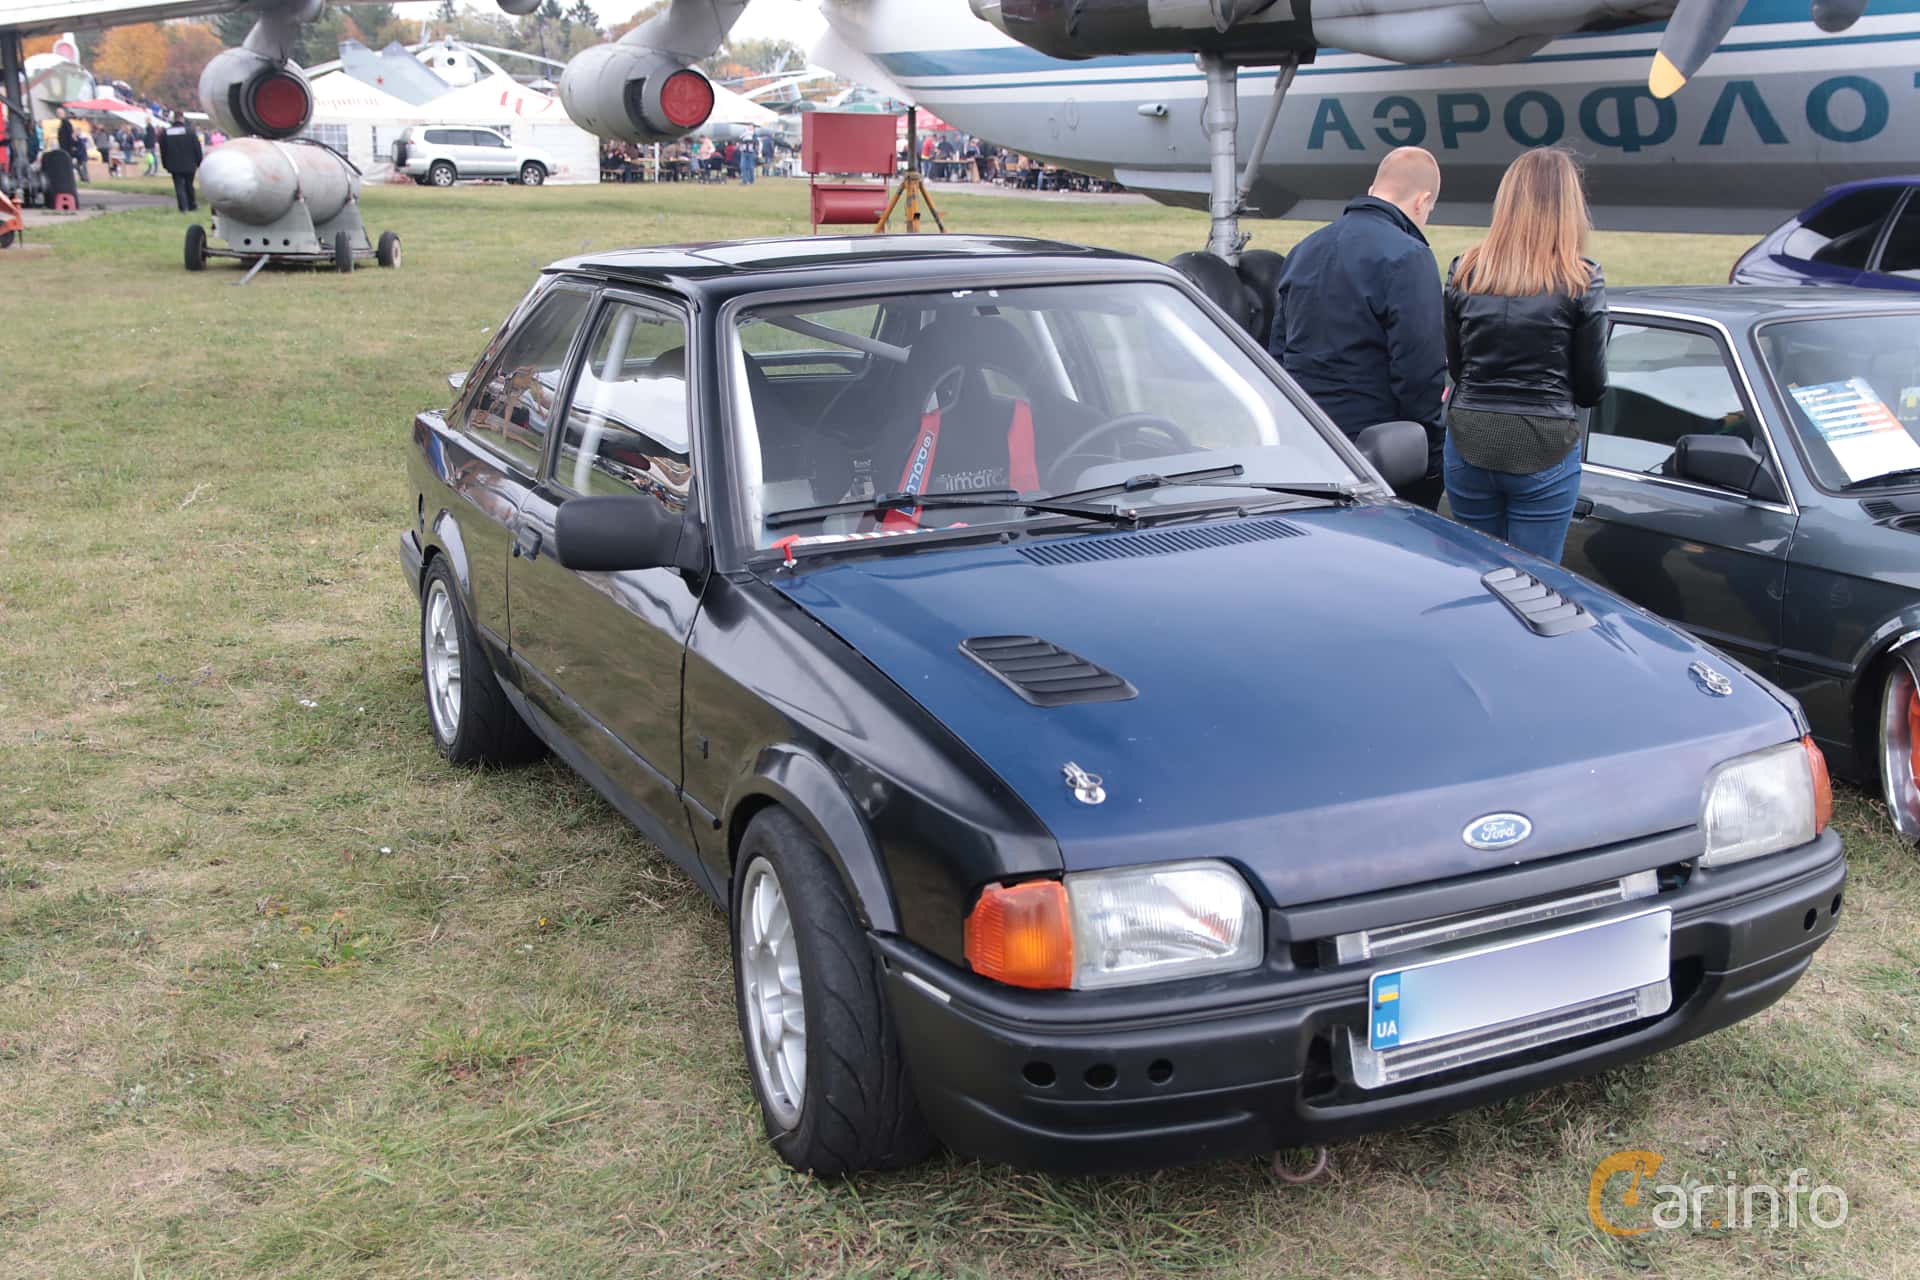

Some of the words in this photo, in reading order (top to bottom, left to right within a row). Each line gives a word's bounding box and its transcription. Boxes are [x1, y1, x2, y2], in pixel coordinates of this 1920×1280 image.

[1307, 71, 1920, 153] АЭРОФЛО
[1480, 820, 1517, 841] Ford
[1376, 1020, 1398, 1039] UA
